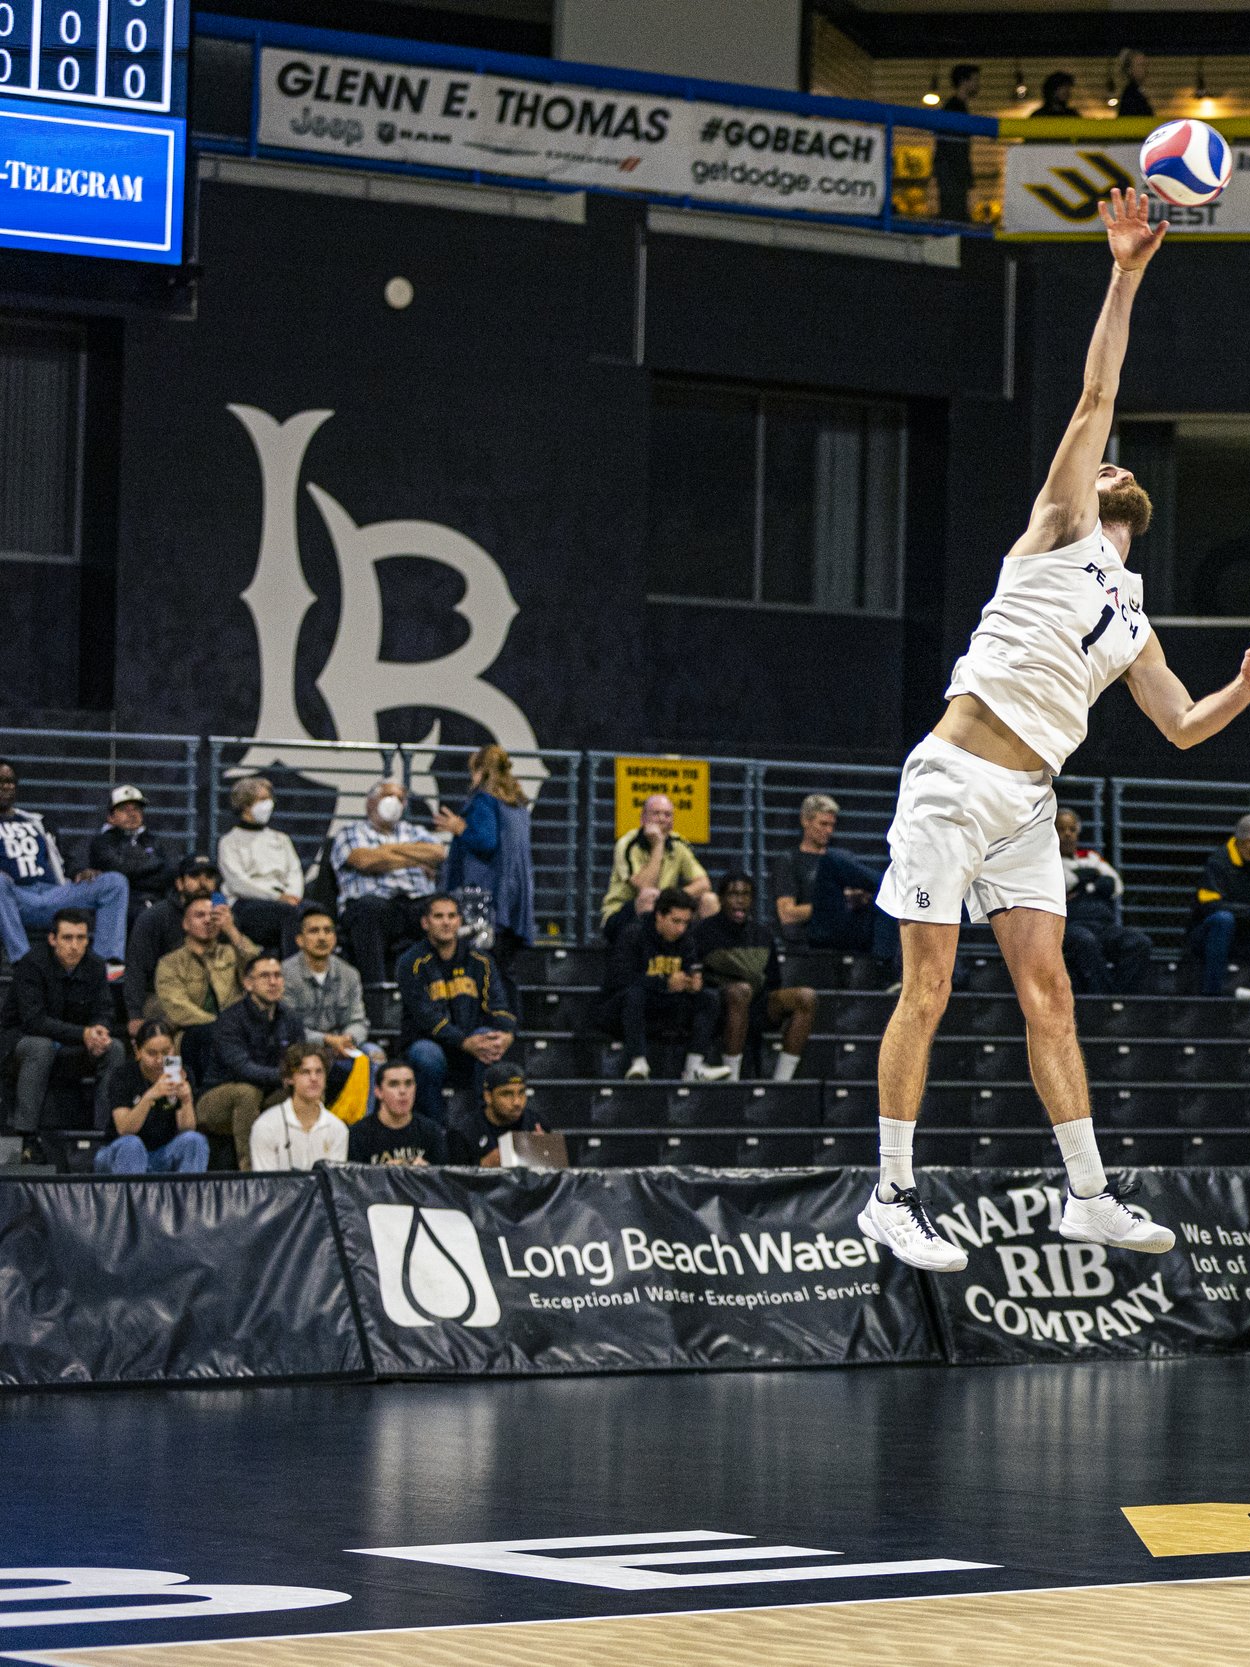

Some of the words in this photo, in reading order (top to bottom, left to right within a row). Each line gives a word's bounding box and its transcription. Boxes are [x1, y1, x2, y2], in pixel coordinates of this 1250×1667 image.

[60, 10, 82, 45] 0
[125, 18, 148, 53] 0
[58, 56, 80, 91] 0
[123, 63, 146, 99] 0
[278, 61, 430, 113] GLENN
[442, 81, 478, 119] E.
[496, 88, 671, 143] THOMAS
[700, 116, 876, 163] #GOBEACH
[692, 160, 877, 198] getdodge.com
[4, 836, 39, 859] DO
[17, 855, 45, 877] IT.
[1180, 1222, 1213, 1245] We
[499, 1236, 614, 1286] Long
[621, 1227, 744, 1276] Beach
[740, 1231, 881, 1274] Water
[995, 1244, 1115, 1298] RIB
[1190, 1252, 1222, 1274] lot
[1226, 1254, 1248, 1274] of
[529, 1287, 640, 1313] Exceptional
[645, 1286, 696, 1304] Water
[706, 1287, 810, 1310] Exceptional
[814, 1281, 881, 1300] Service
[965, 1272, 1174, 1344] COMPANY
[1201, 1282, 1240, 1301] but
